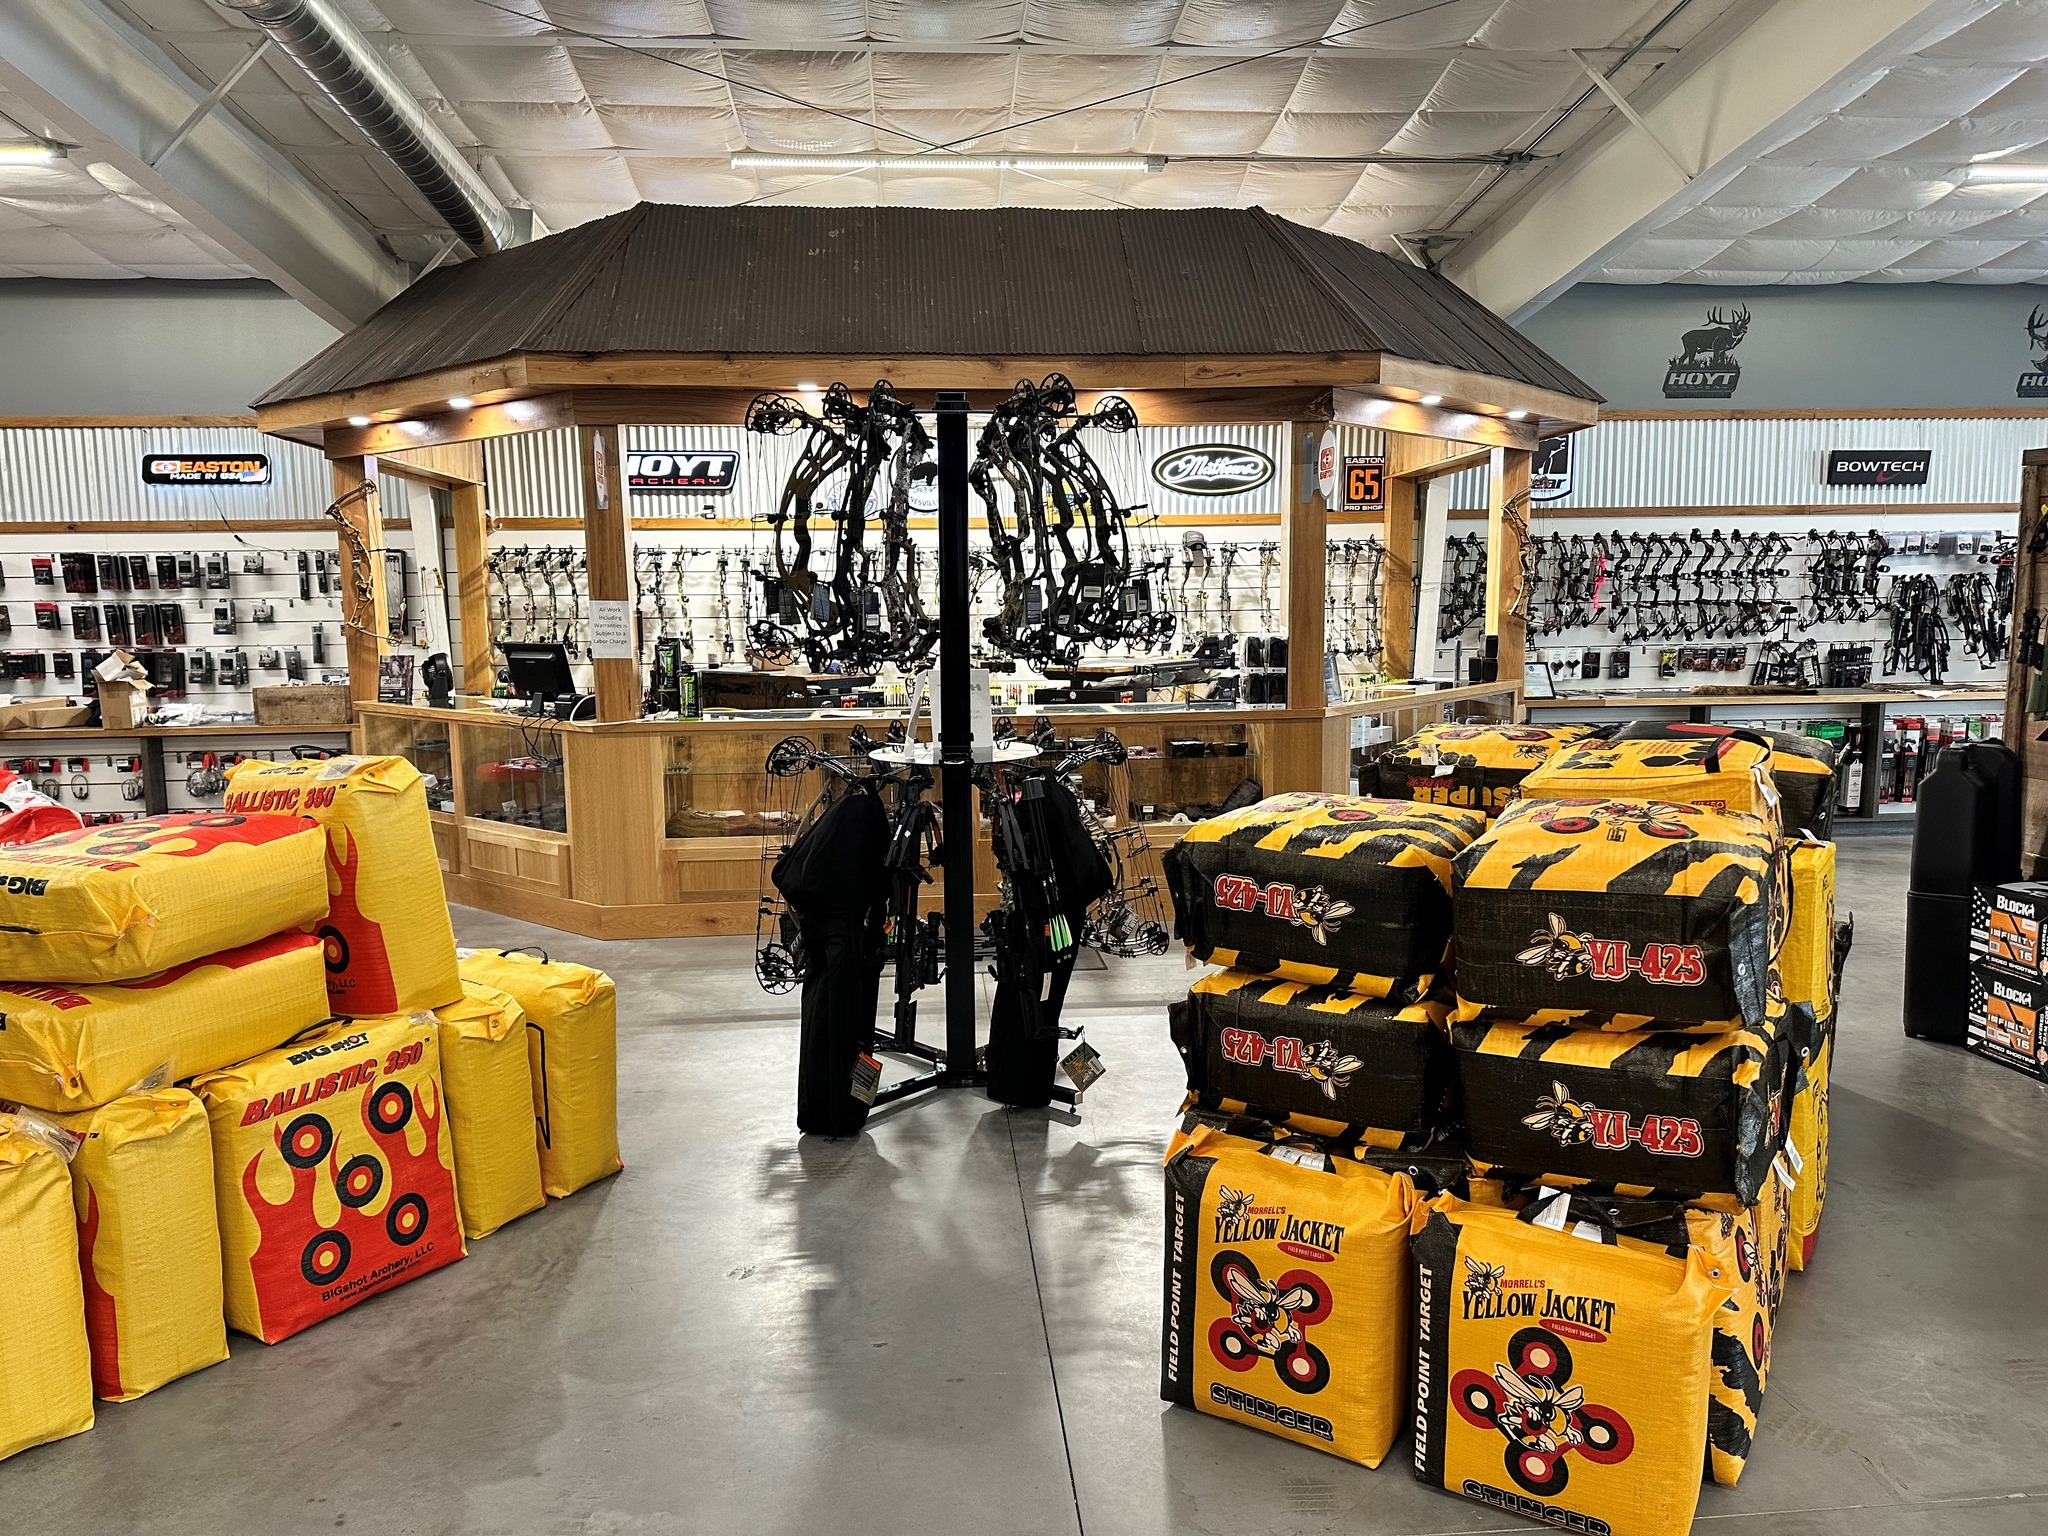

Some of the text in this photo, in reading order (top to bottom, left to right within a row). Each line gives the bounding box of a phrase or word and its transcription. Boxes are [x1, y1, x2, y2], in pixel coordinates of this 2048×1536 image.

[1668, 372, 1736, 385] HOYT
[2021, 375, 2048, 387] HO
[181, 460, 261, 474] EASTON
[1163, 454, 1264, 482] Mathews
[1344, 456, 1385, 464] EASTON
[1836, 460, 1926, 473] BOWTECH
[169, 472, 243, 480] MADE IN USA
[629, 477, 721, 486] RCHERY
[1350, 468, 1379, 500] 6.5
[224, 787, 300, 814] BALLISTIC
[303, 785, 337, 810] 350
[1412, 785, 1512, 808] SUPER
[1213, 872, 1298, 921] YJ-425
[1996, 894, 2031, 917] BLOCK
[1989, 927, 2036, 948] INFINITY
[1587, 936, 1707, 986] YJ-425
[2019, 950, 2034, 962] 16
[1993, 980, 2028, 1006] BLOCK
[1987, 1013, 2033, 1037] INFINITY
[286, 1032, 369, 1066] BIG SHOT
[1220, 1026, 1305, 1073] YJ-425
[2016, 1037, 2030, 1050] 16
[239, 1058, 378, 1127] BALLISTIC
[382, 1041, 423, 1076] 350
[1590, 1108, 1705, 1158] YJ-425
[1247, 1206, 1287, 1215] MORRELL'S
[1214, 1214, 1346, 1254] YELLOW JACKET
[321, 1241, 434, 1302] BIGshot Archery, LLC
[1499, 1279, 1546, 1289] MORRELL'S
[1166, 1191, 1186, 1383] FIELD POINT TARGET
[1462, 1288, 1616, 1334] YELLOW JACKET
[1551, 1322, 1597, 1340] FIELD POINT TARGET
[1415, 1263, 1433, 1472] FIELD POINT TARGET
[1210, 1382, 1334, 1442] STINGER
[1462, 1478, 1612, 1536] STINGER
